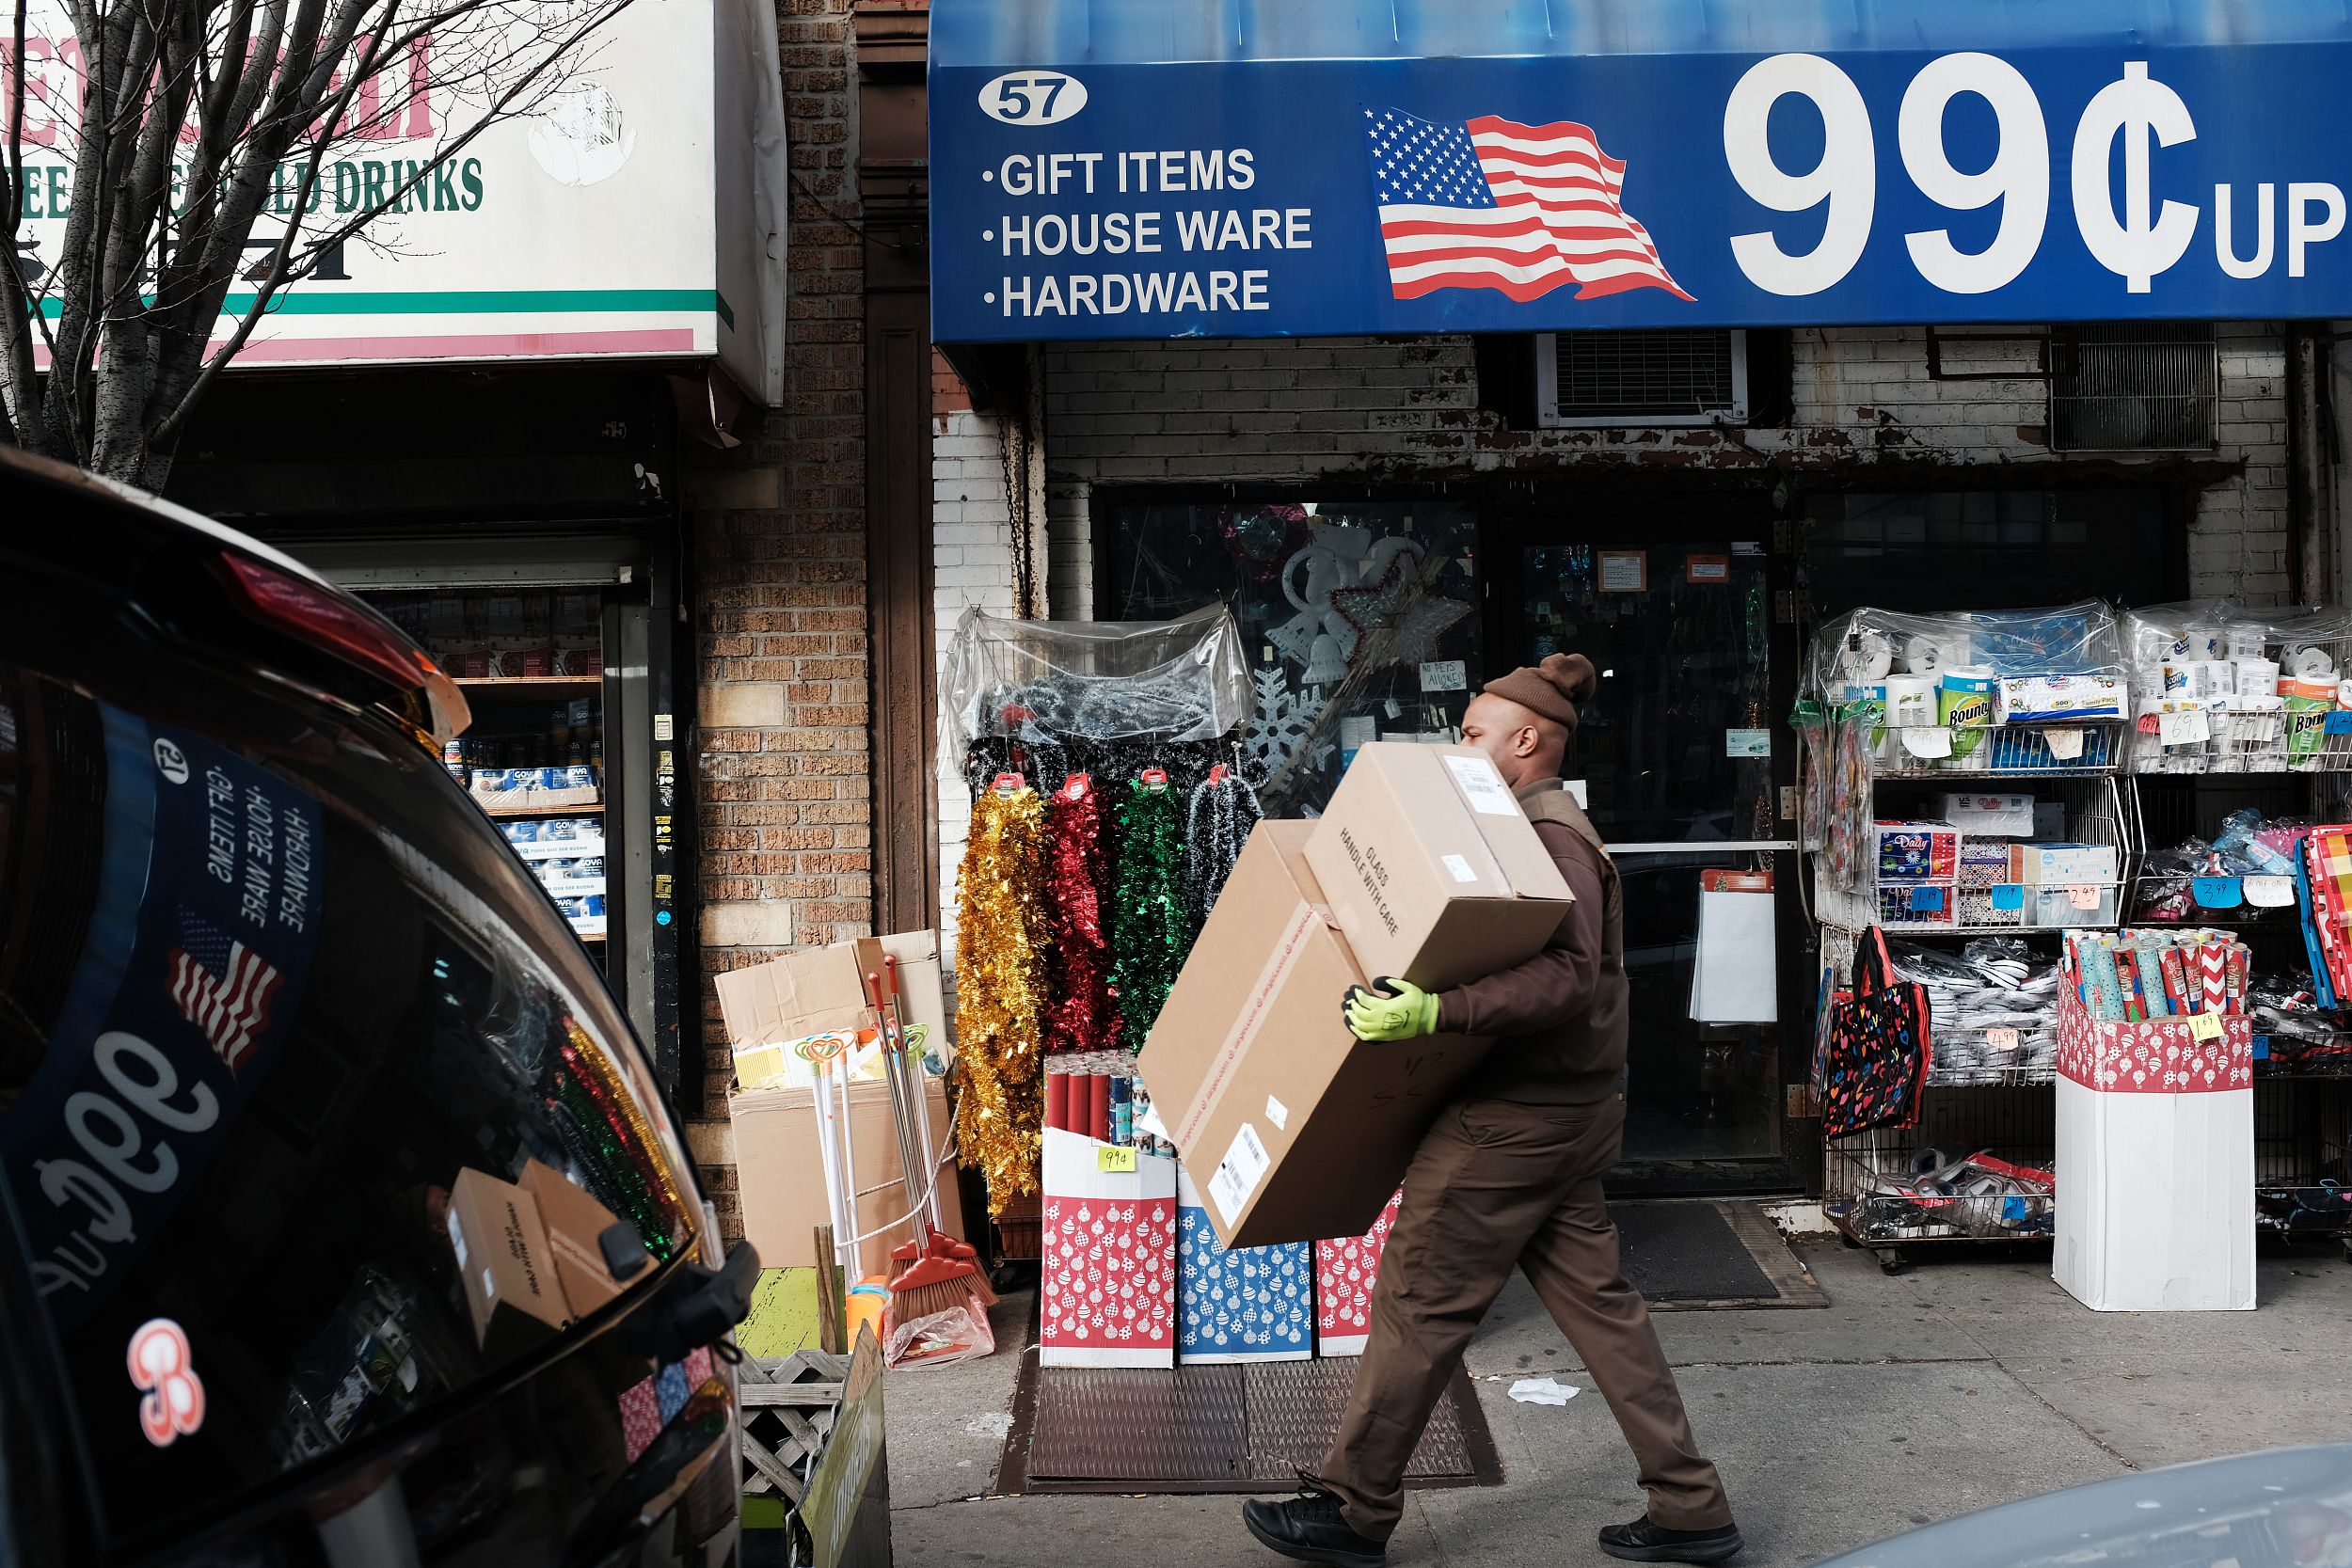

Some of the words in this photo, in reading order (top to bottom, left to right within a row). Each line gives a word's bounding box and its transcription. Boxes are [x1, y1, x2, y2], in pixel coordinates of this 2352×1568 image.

[997, 78, 1067, 119] 57
[335, 157, 484, 214] DRINKS
[1000, 153, 1104, 196] GIFT
[1118, 149, 1255, 192] ITEMS
[1724, 52, 2200, 295] 99¢
[2215, 182, 2346, 278] UP
[1002, 212, 1162, 257] HOUSE
[1176, 208, 1312, 251] WARE
[1003, 270, 1270, 317] HARDWARE
[1422, 664, 1431, 673] NO
[1435, 662, 1455, 673] PETS
[2165, 671, 2185, 686] Scott
[1948, 701, 1991, 726] Bounty
[2295, 711, 2328, 734] Boun
[1894, 834, 1930, 850] Daisy
[1340, 827, 1366, 875] HANDLE
[1363, 871, 1382, 906] WITH
[1378, 903, 1399, 938] CARE
[1366, 847, 1389, 887] GLASS
[555, 898, 573, 907] OYA
[2203, 883, 2227, 903] 3.99
[1263, 955, 1287, 997] target.com
[1233, 1008, 1258, 1049] target.com
[1206, 1060, 1230, 1100] target.com
[1181, 1110, 1202, 1147] target.com
[1105, 1150, 1127, 1168] 99¢
